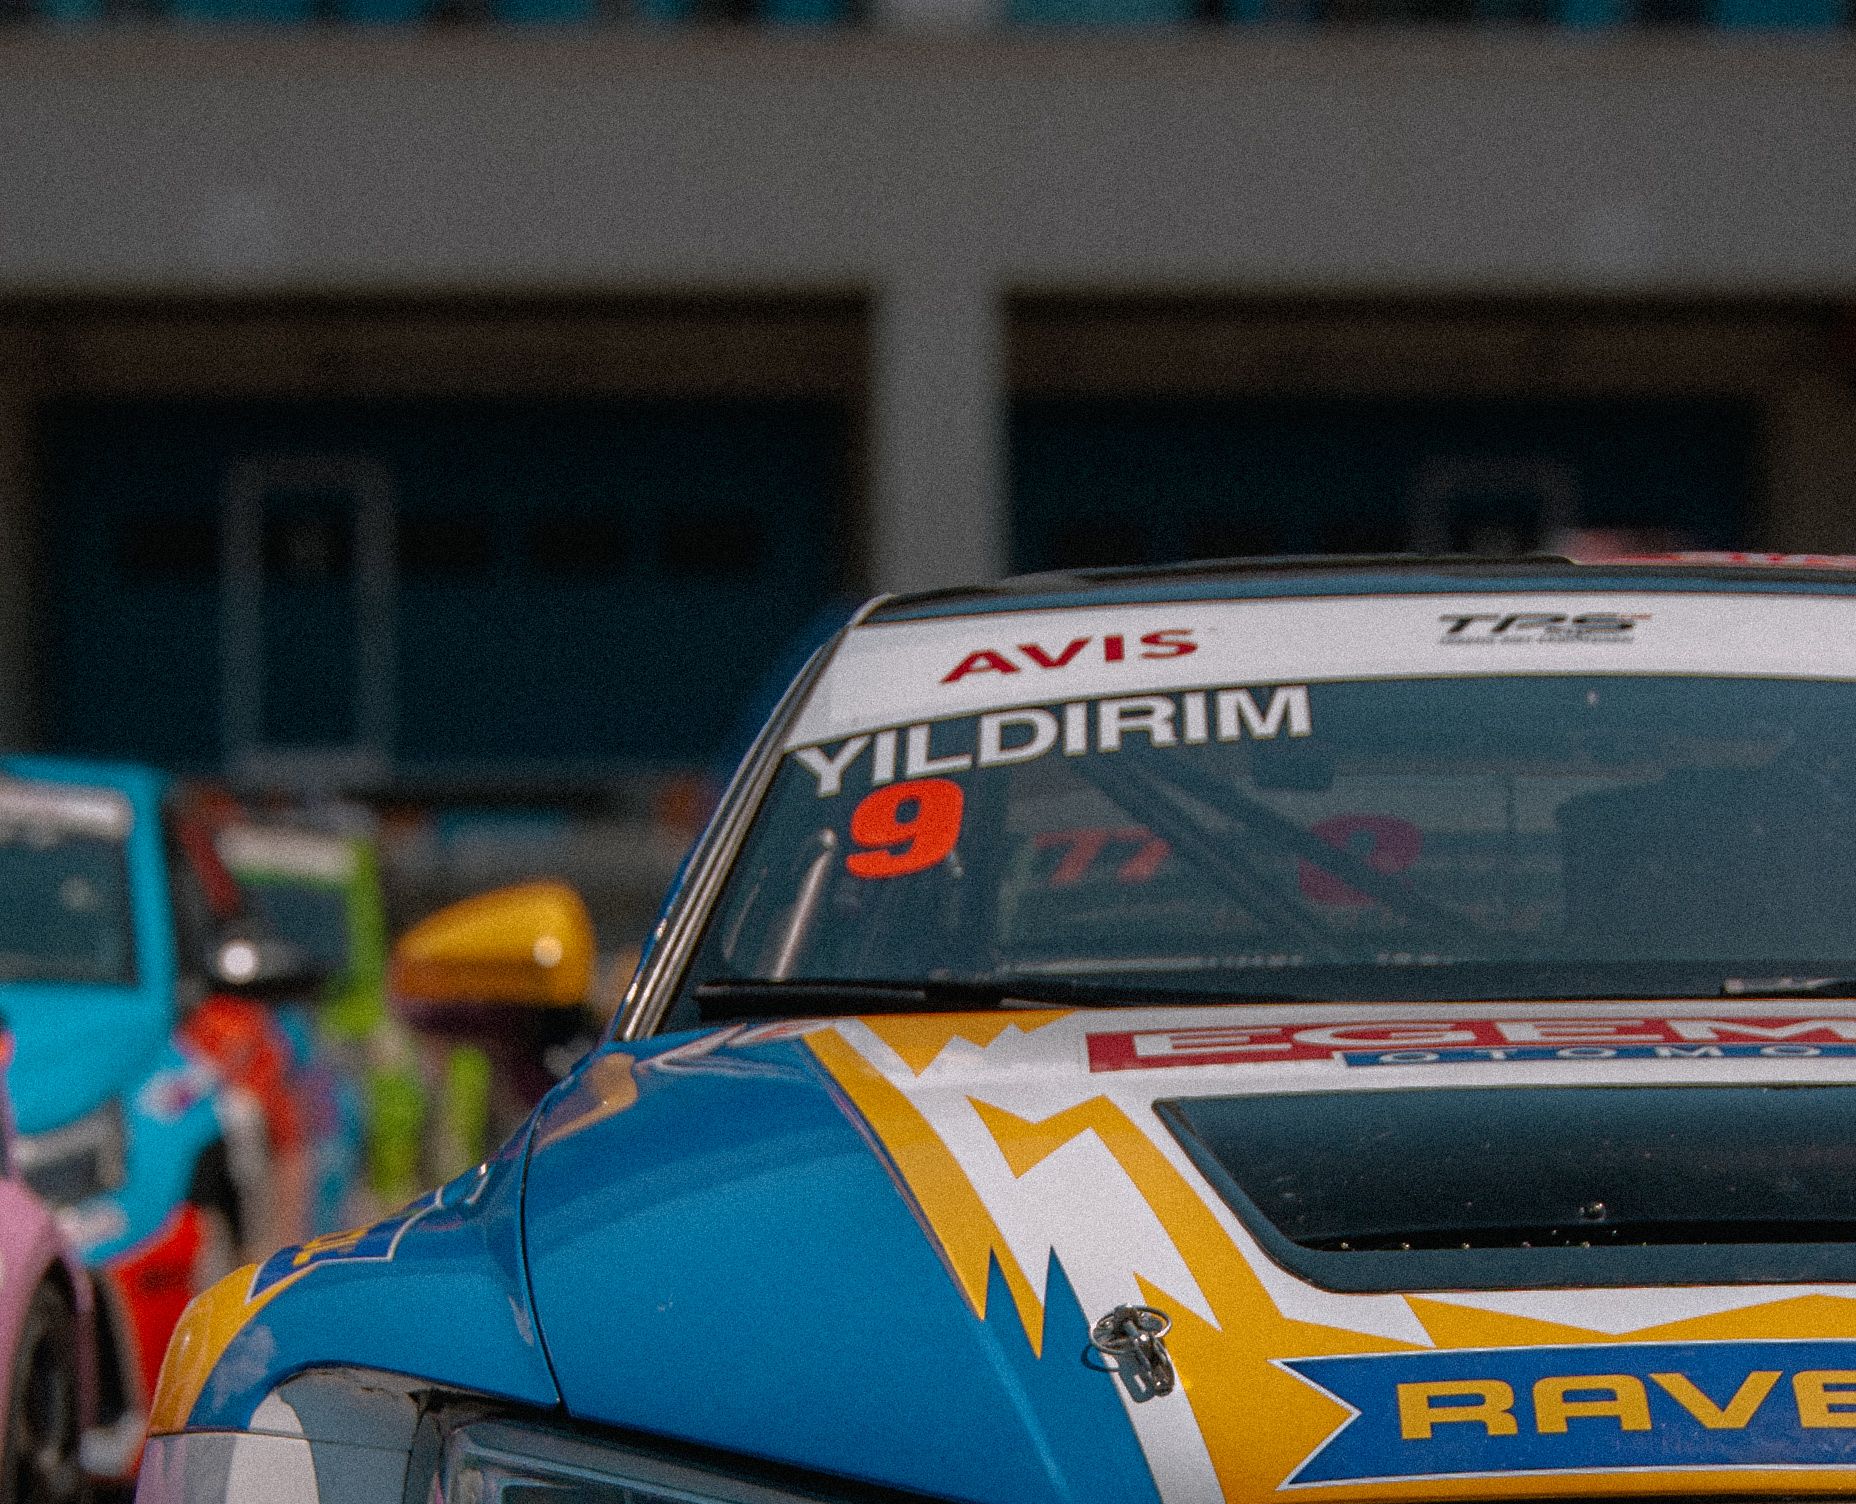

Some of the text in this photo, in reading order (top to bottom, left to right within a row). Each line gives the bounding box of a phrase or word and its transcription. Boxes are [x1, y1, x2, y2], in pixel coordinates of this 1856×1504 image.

[940, 628, 1199, 684] AVIS
[795, 684, 1313, 798] YILDIRIM
[845, 777, 964, 879] 9
[1134, 1017, 1856, 1057] EGEM
[1379, 1043, 1823, 1065] OTOMO
